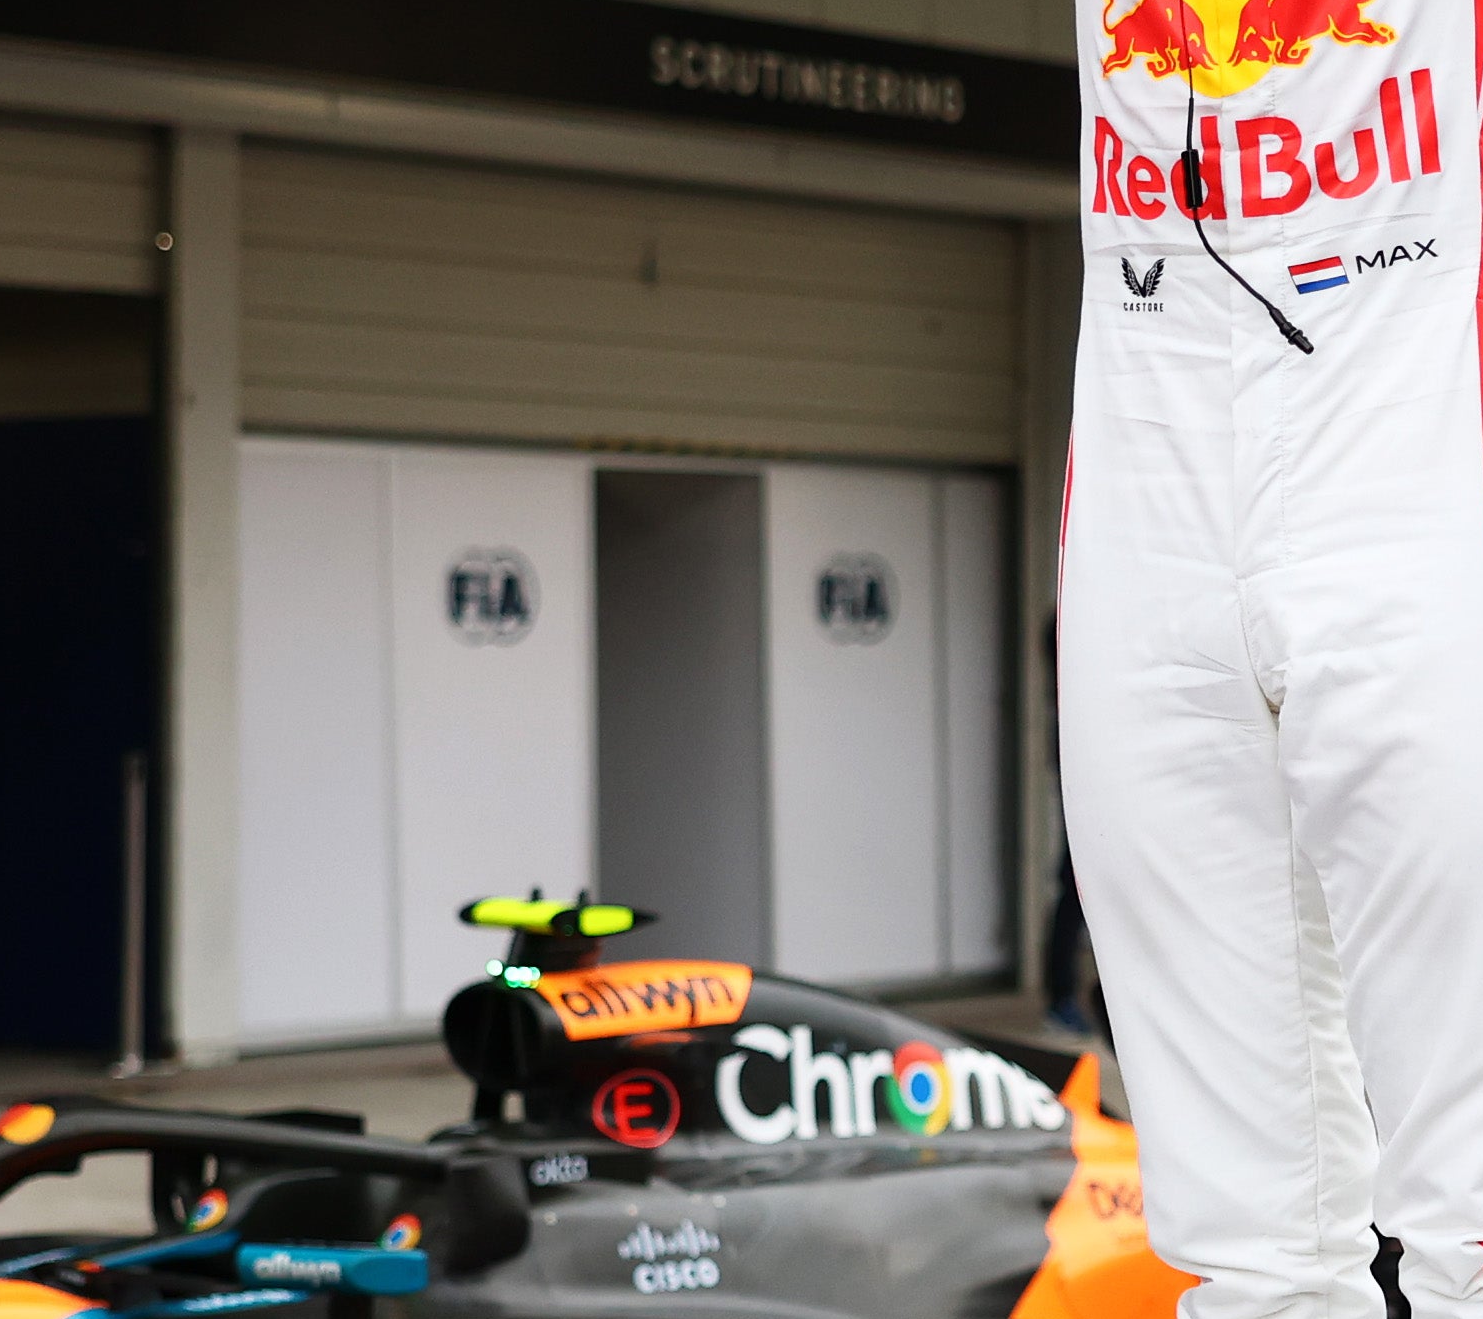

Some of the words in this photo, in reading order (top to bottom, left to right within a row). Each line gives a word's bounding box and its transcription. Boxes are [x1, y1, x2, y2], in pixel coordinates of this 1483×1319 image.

[648, 34, 967, 126] SCRUTINEERING
[1090, 114, 1219, 222] Red
[1233, 67, 1442, 219] Bull
[1355, 238, 1438, 275] MAX
[1123, 301, 1165, 313] CASTORE
[447, 567, 530, 624] FIA
[816, 568, 890, 624] FIA
[559, 974, 740, 1028] allwyn
[718, 1022, 1065, 1145] Chrome
[633, 1257, 720, 1294] cisco
